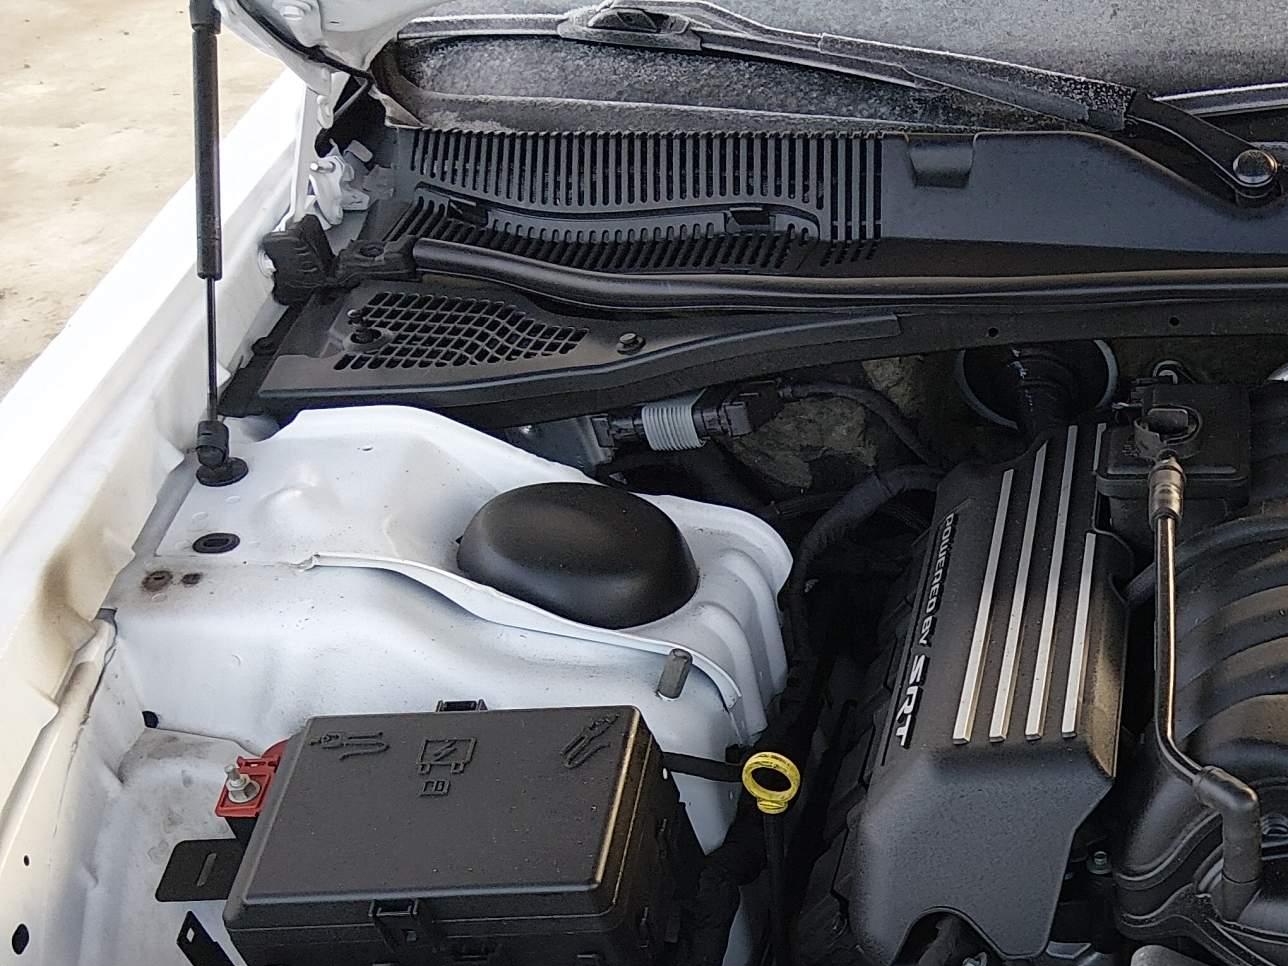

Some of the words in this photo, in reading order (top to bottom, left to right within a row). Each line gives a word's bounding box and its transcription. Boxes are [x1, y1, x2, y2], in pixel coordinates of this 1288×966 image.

[925, 512, 956, 614] POWERED
[918, 615, 935, 647] BY
[895, 654, 927, 748] SRT
